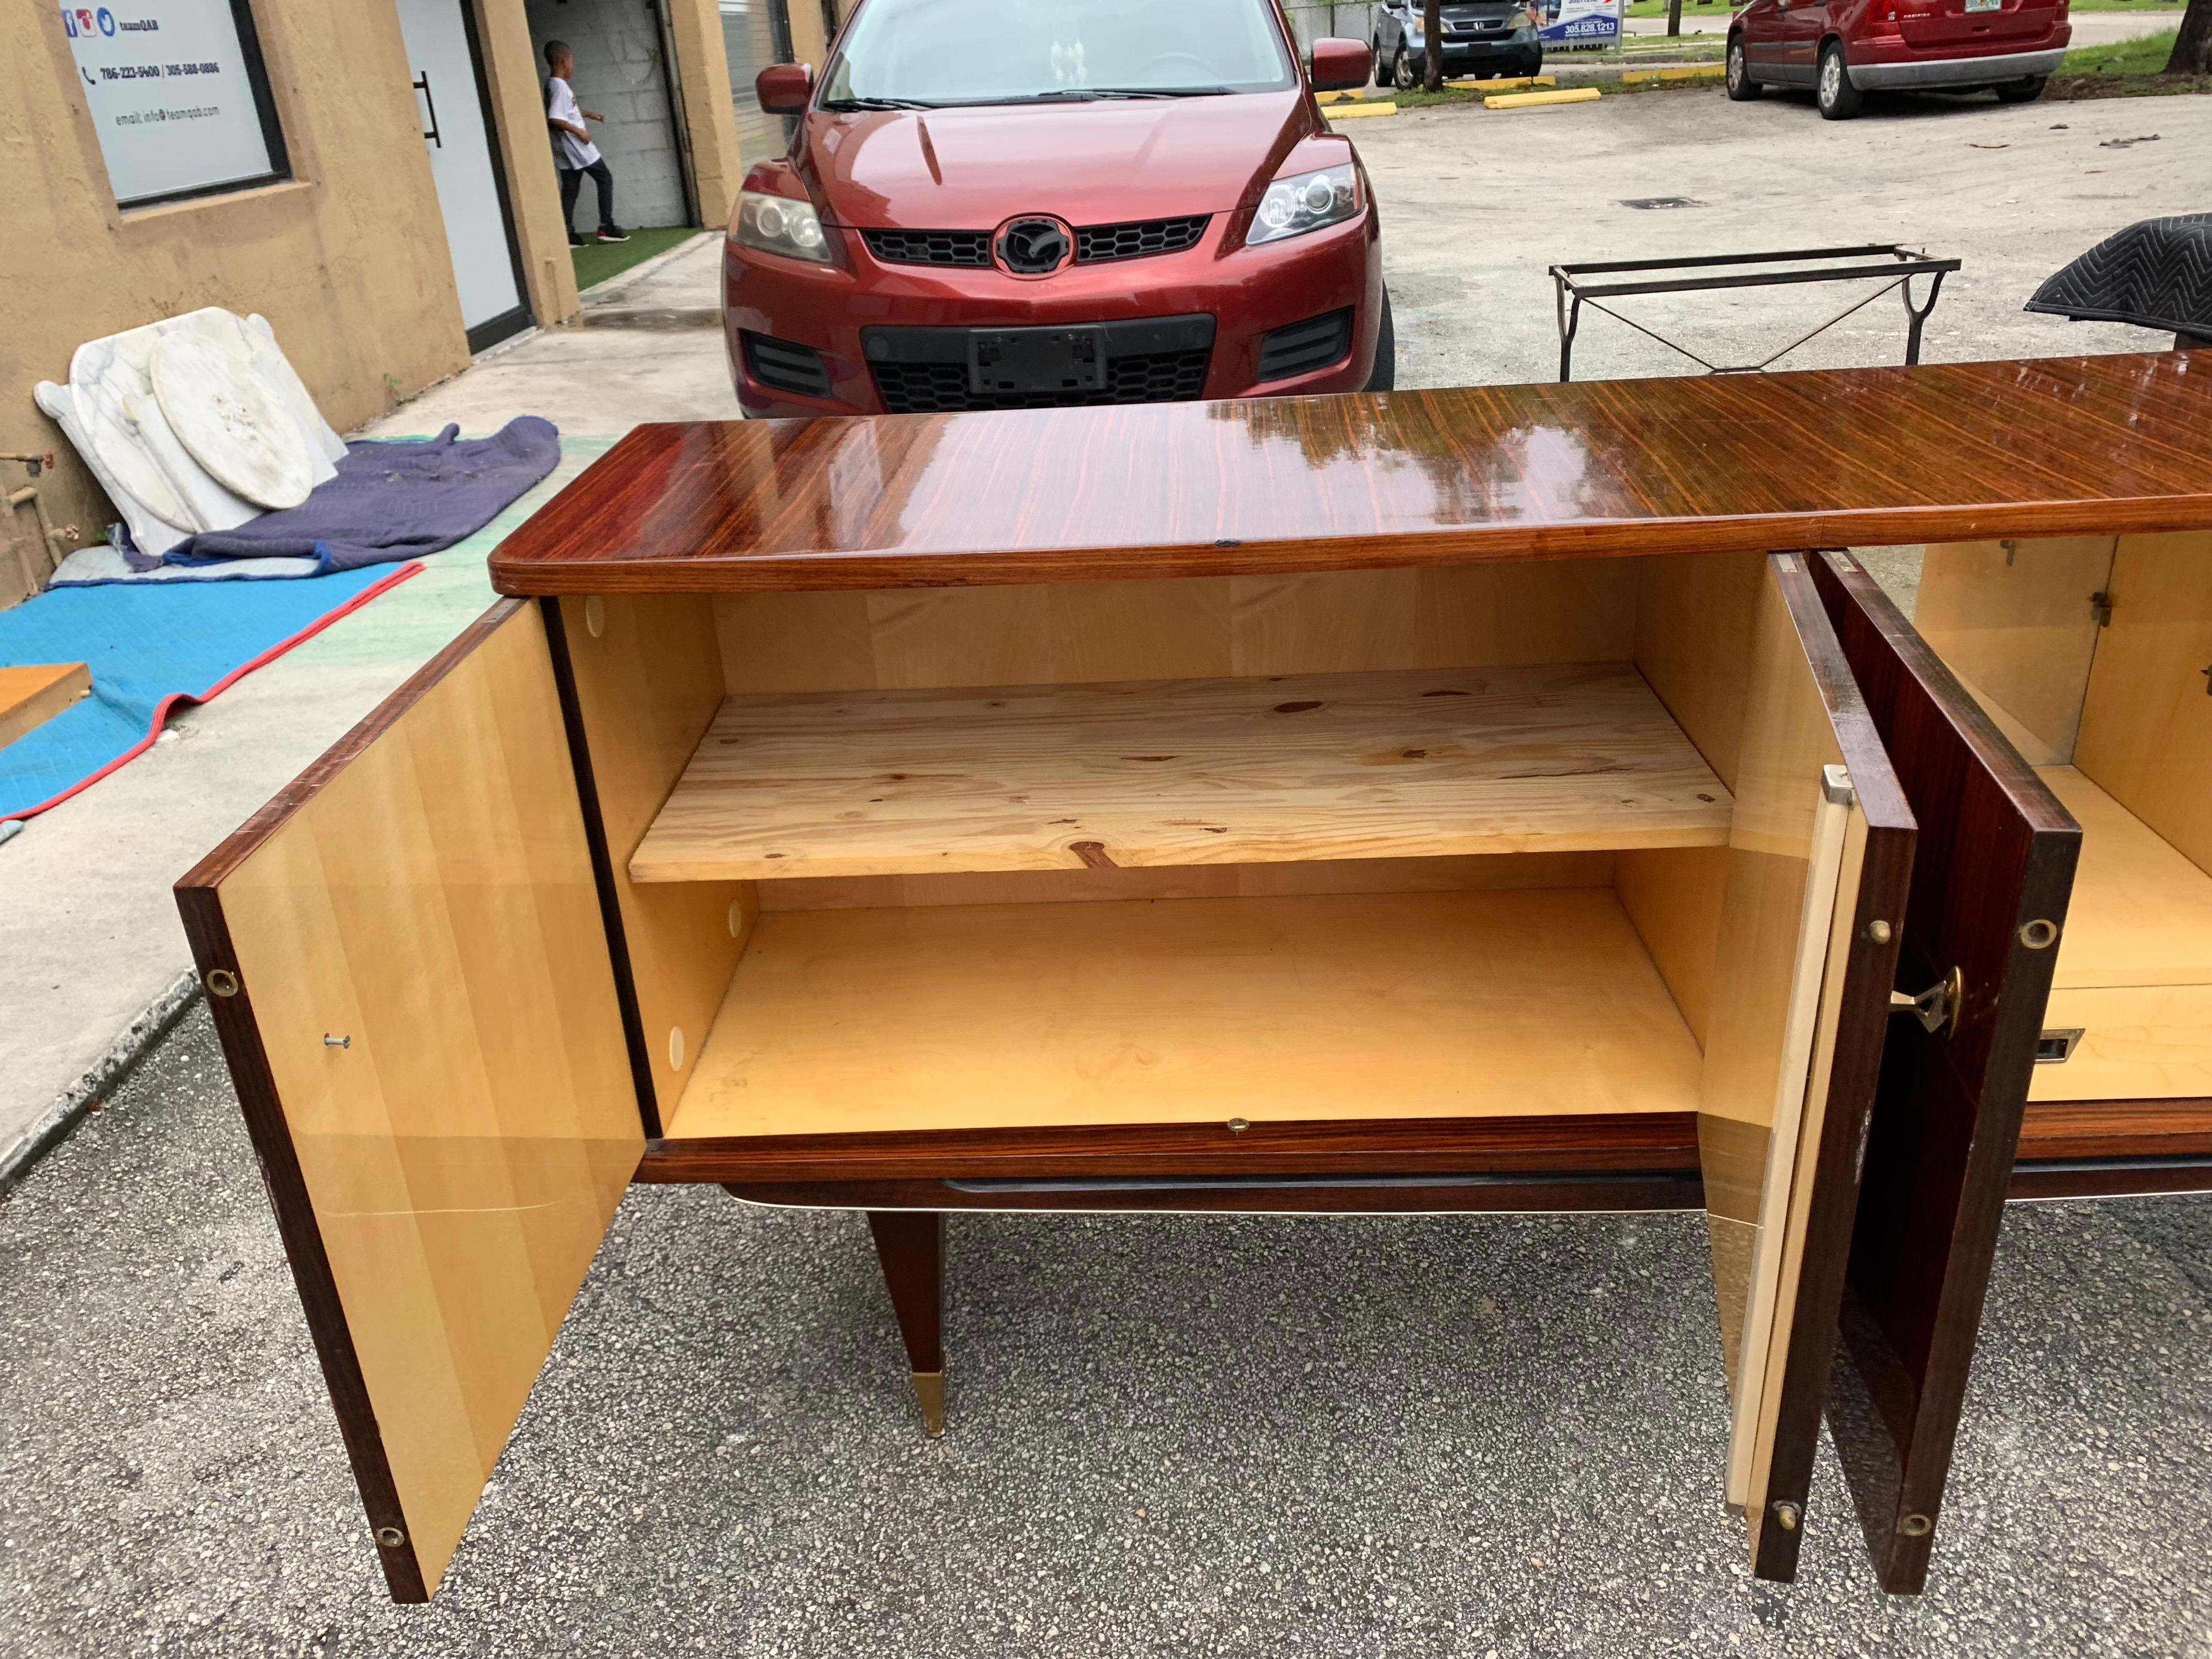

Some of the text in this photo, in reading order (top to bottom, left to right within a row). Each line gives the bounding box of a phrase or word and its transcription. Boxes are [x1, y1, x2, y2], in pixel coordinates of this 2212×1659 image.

[119, 19, 159, 31] teamQAB
[1564, 22, 1615, 34] 305.828.1213
[100, 66, 160, 80] 786-223-5400
[116, 111, 142, 126] email:
